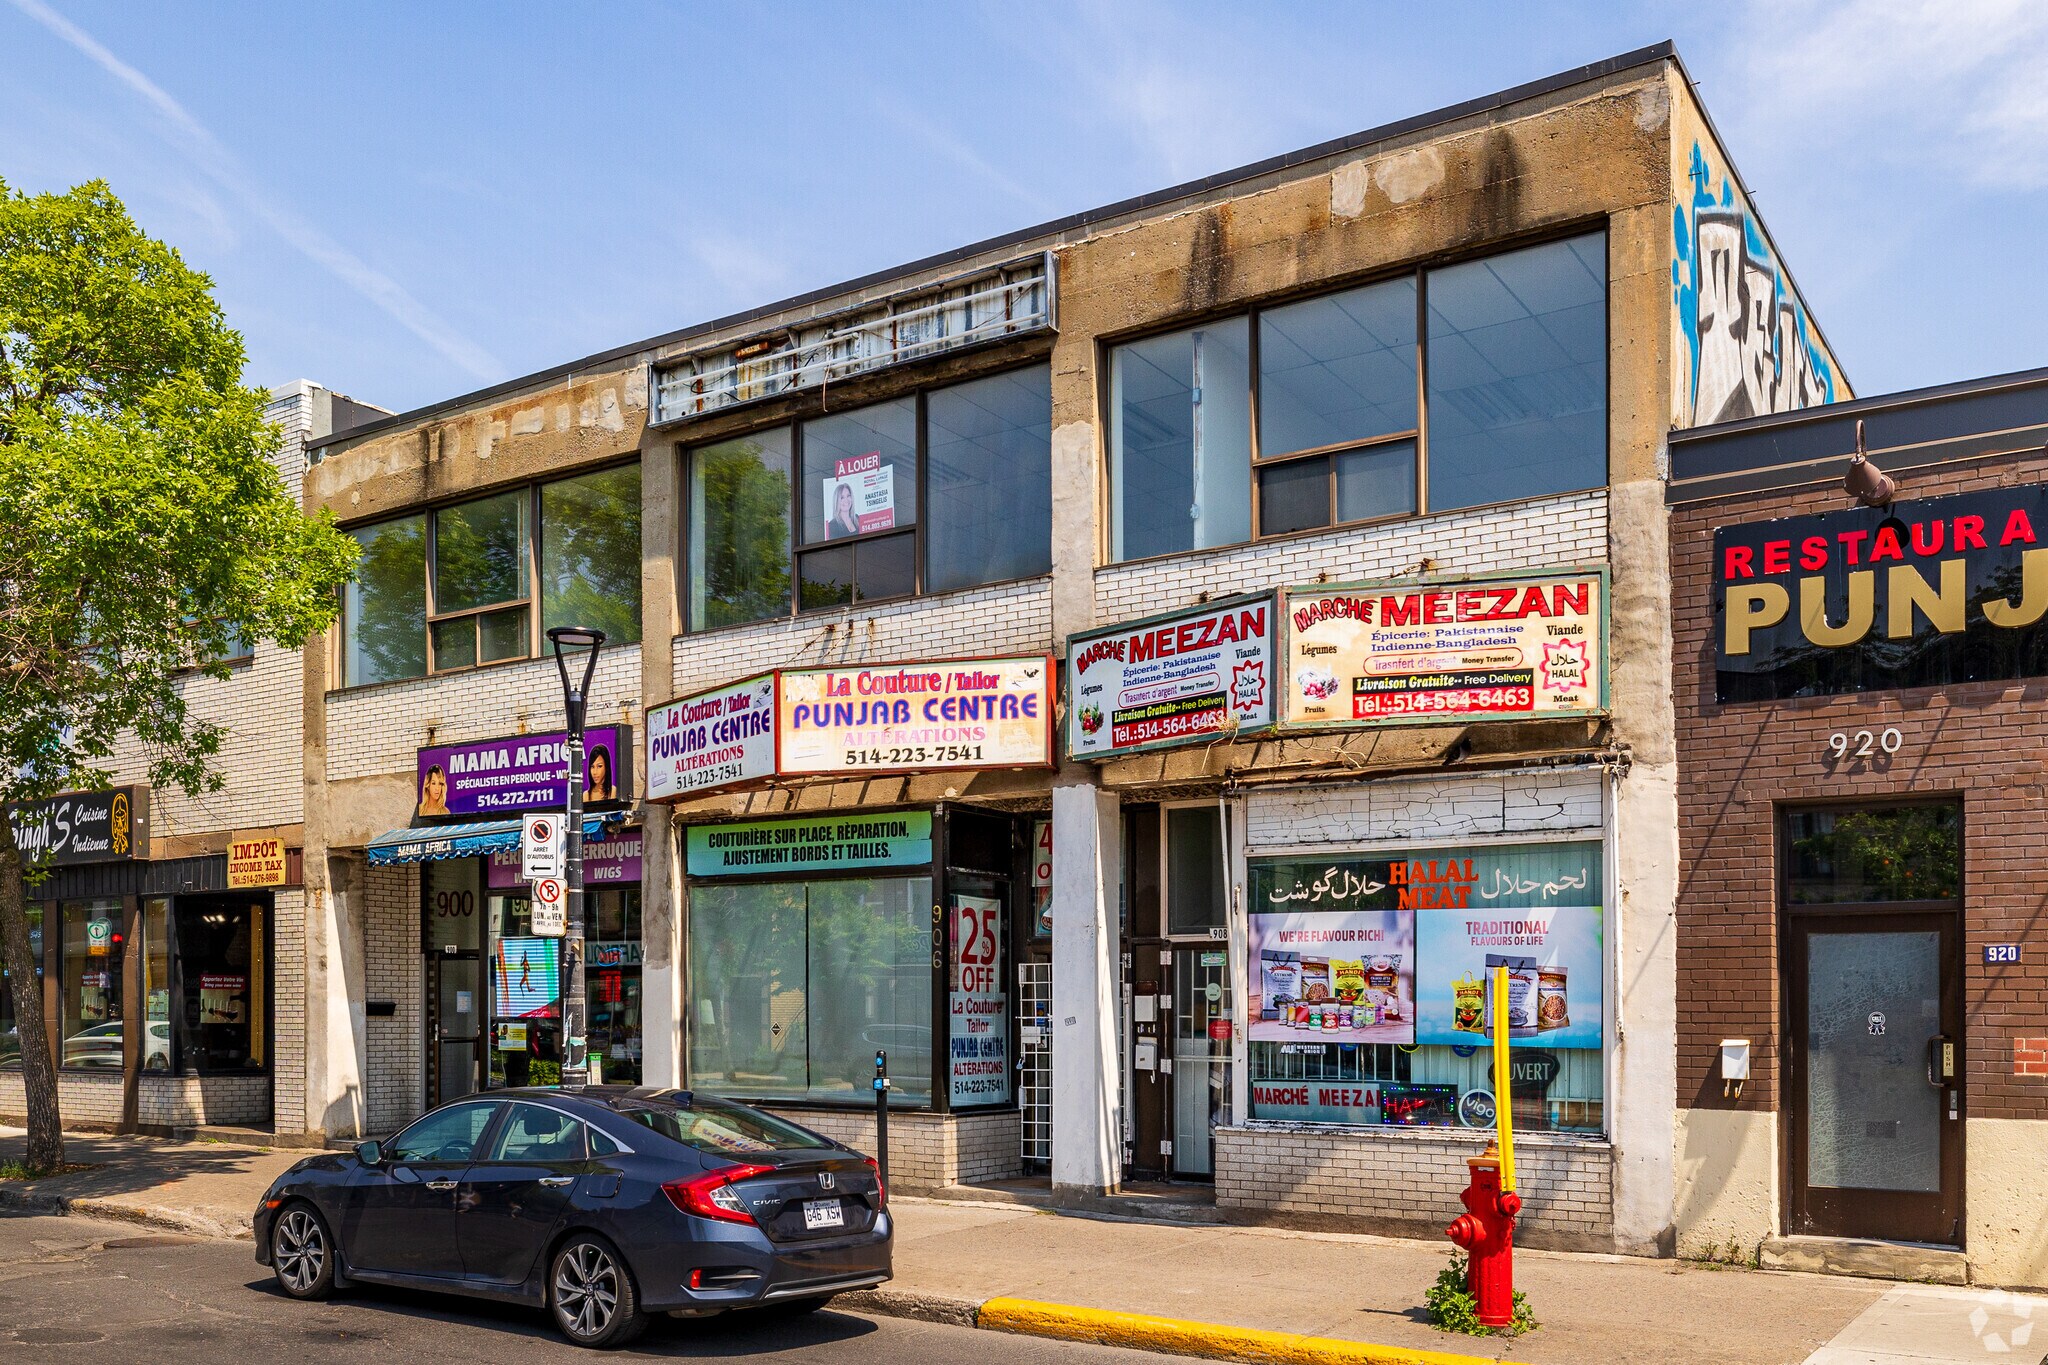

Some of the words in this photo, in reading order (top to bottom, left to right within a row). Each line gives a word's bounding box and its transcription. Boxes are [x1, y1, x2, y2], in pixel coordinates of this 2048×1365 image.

[838, 461, 846, 475] À
[848, 455, 879, 473] LOUER
[1724, 508, 2038, 580] RESTAURA
[1380, 582, 1589, 627] MEEZAN
[1724, 548, 2048, 656] PUNJ
[1129, 606, 1266, 665] MEEZAN
[1371, 629, 1430, 643] Épicerie:
[1435, 624, 1525, 638] Pakistanaise
[1546, 624, 1583, 636] Viande
[1235, 646, 1261, 660] Viande
[1301, 643, 1337, 657] Légumes
[1371, 636, 1517, 652] Indienne-Bangladesh
[1123, 665, 1160, 679] Épicerie:
[1163, 651, 1221, 669] Pakistanaise
[1461, 657, 1485, 665] Money
[1486, 655, 1515, 663] Transfer
[1551, 653, 1578, 666] حلال
[1123, 663, 1216, 687] Indienne-Bangladesh
[1237, 675, 1258, 688] حلال
[1356, 676, 1407, 691] Livraison
[1463, 673, 1487, 685] Free
[1489, 671, 1532, 685] Delivery
[1552, 668, 1579, 678] HALAL
[826, 673, 851, 698] La
[857, 669, 942, 696] Couture
[955, 670, 1001, 691] Tailor
[1081, 684, 1103, 697] Légumes
[1180, 684, 1195, 692] Money
[1196, 680, 1215, 689] Transfer
[1238, 688, 1258, 699] HALAL
[667, 708, 679, 730] La
[681, 697, 722, 726] Couture
[728, 693, 751, 714] Tailor
[793, 699, 911, 730] PUNJAB
[923, 692, 1038, 723] CENTRE
[1114, 708, 1146, 723] Livraison
[1181, 701, 1197, 711] Free
[1198, 696, 1226, 708] Delivery
[1239, 712, 1258, 721] Meat
[652, 725, 707, 762] PUNJAB
[711, 707, 770, 745] CENTRE
[842, 726, 987, 747] ALTÉRATIONS
[1083, 739, 1096, 747] Fruits
[1829, 727, 1903, 759] 920
[449, 748, 510, 775] MAMA
[515, 742, 587, 766] AFRIC
[675, 744, 744, 774] ALTÉRATIONS
[845, 744, 984, 766] 514-223-7541
[456, 774, 500, 790] SPÉCIALISTE
[500, 775, 510, 787] EN
[510, 771, 551, 785] PERRUQUE
[676, 763, 744, 790] 514-223-7541
[477, 788, 554, 808] 514.272.7111
[75, 804, 108, 826] Cuisine
[775, 822, 797, 845] SUR
[799, 820, 835, 843] PLACE,
[72, 834, 108, 854] Indienne
[233, 840, 278, 860] IMPÔT
[398, 845, 421, 856] MAMA
[425, 840, 451, 854] AFRICA
[583, 841, 642, 862] ERRUQUE
[722, 844, 789, 867] AJUSTEMENT
[791, 842, 830, 862] BORDS
[832, 842, 845, 860] ET
[846, 841, 892, 861] TAILLES.
[230, 861, 262, 873] INCOME
[265, 860, 282, 871] TAX
[594, 866, 622, 879] WIGS
[1389, 858, 1480, 886] HALAL
[1269, 866, 1338, 903] گوشت
[1331, 870, 1386, 899] حلال
[1481, 868, 1541, 899] حلال
[1543, 868, 1587, 900] لحم
[437, 890, 474, 917] 900
[514, 899, 533, 912] 90
[1397, 885, 1473, 910] MEAT
[932, 905, 943, 969] 906
[961, 906, 996, 965] 25
[981, 940, 991, 957] %
[1213, 929, 1228, 939] 908
[1279, 930, 1309, 943] WE'RE
[1311, 930, 1355, 942] FLAVOUR
[1357, 929, 1385, 942] RICH!
[1466, 920, 1549, 935] TRADITIONAL
[1471, 936, 1512, 946] FLAVOURS
[1514, 936, 1525, 946] OF
[1527, 936, 1544, 945] LIFE
[1988, 946, 2017, 962] 920
[962, 967, 995, 993] OFF
[952, 998, 964, 1014] La
[966, 998, 1003, 1015] Couture
[966, 1019, 989, 1033] Tailor
[952, 1036, 978, 1059] PUNJAB
[953, 1059, 1004, 1076] ALTÉRATIONS
[1510, 1062, 1551, 1081] UVERT
[954, 1078, 1004, 1095] 514-223-7541
[1253, 1085, 1309, 1105] MARCHÉ
[1465, 1097, 1495, 1118] vigo
[807, 1207, 822, 1222] G46
